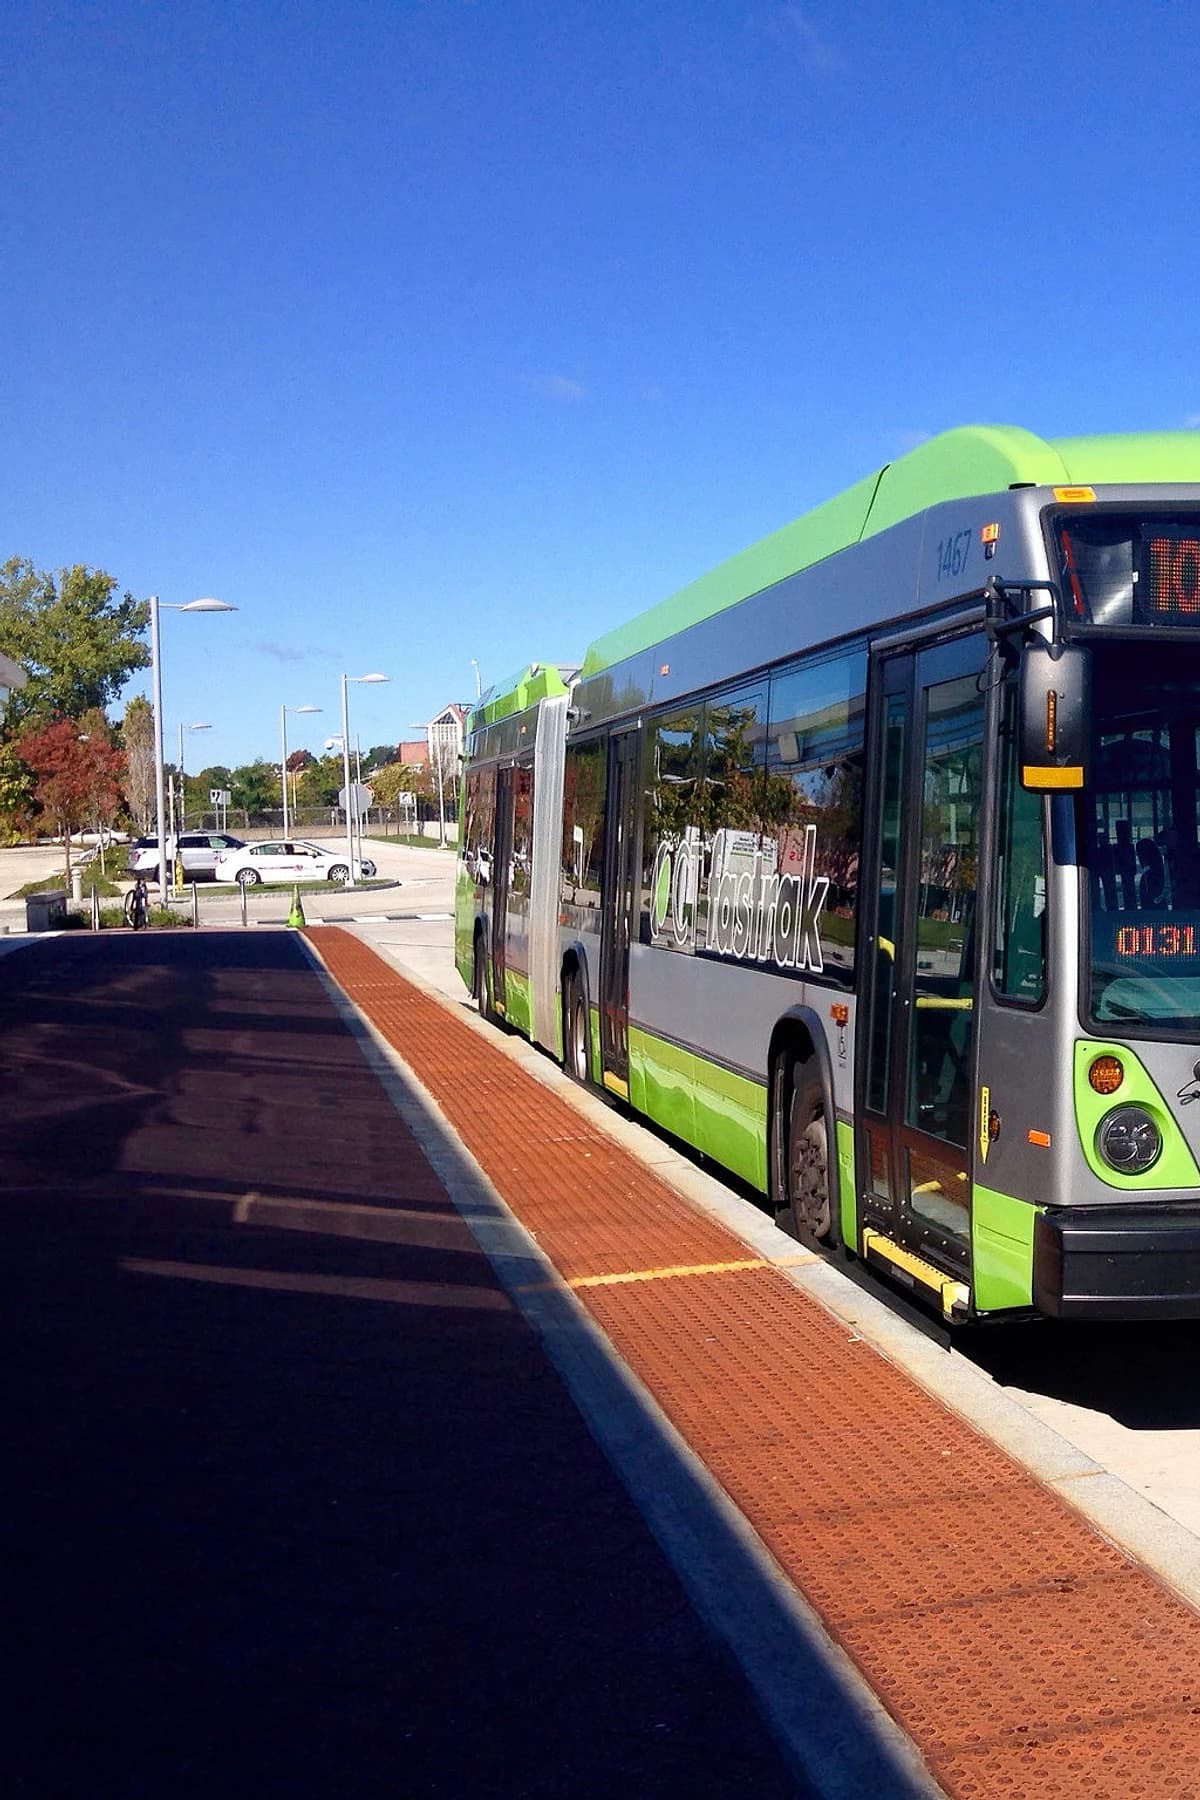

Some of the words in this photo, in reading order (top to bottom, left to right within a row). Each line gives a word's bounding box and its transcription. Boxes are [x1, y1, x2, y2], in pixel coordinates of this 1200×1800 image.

[937, 528, 972, 582] 1467
[706, 824, 830, 974] fastrak
[1117, 926, 1197, 955] 0131
